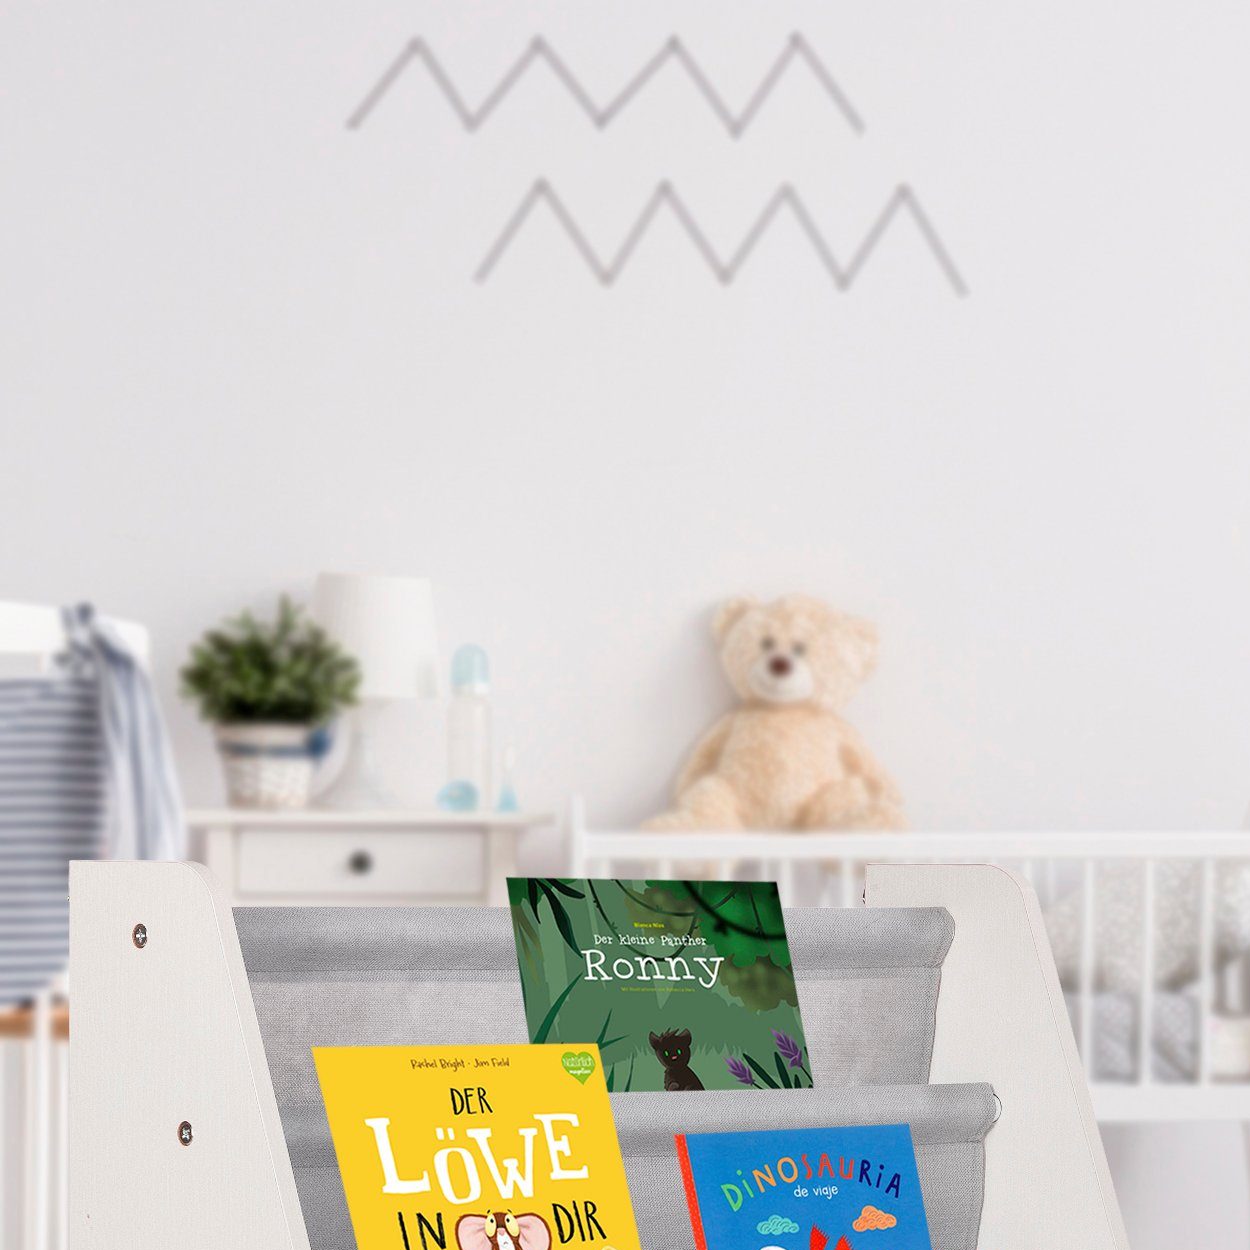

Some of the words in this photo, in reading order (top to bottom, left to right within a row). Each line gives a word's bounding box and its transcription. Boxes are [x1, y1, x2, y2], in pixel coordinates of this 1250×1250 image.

[594, 934, 613, 945] Der
[619, 934, 655, 945] kleine
[660, 934, 707, 947] Panther
[581, 949, 725, 989] Ronny
[410, 1058, 438, 1070] Rachel
[440, 1057, 465, 1073] Bright
[474, 1058, 490, 1068] Jim
[491, 1057, 510, 1068] Field
[450, 1086, 493, 1115] DER
[364, 1113, 590, 1205] LÖWE
[793, 1185, 809, 1198] de
[813, 1184, 839, 1200] viaje
[552, 1200, 607, 1244] DIR
